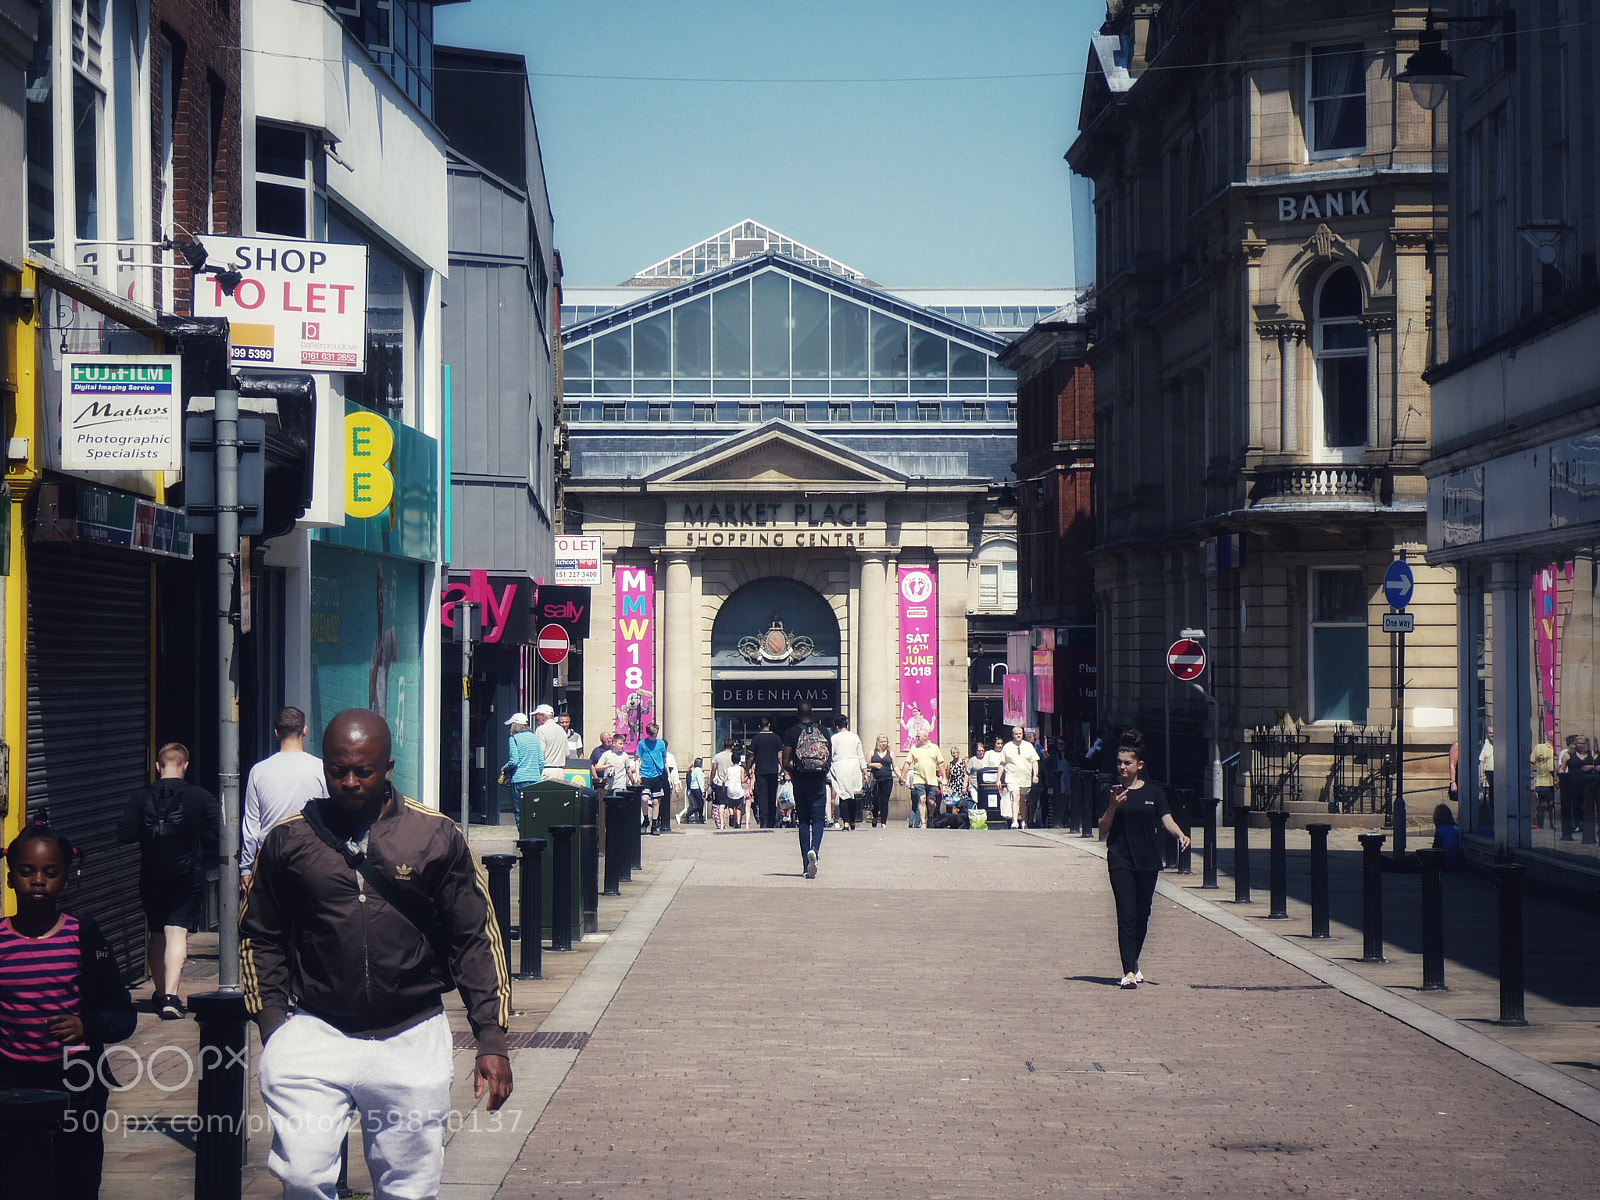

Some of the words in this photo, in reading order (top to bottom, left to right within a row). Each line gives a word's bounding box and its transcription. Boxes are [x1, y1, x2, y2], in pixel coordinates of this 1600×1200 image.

[1278, 188, 1370, 221] BANK
[235, 246, 327, 274] SHOP
[206, 277, 266, 310] TO
[283, 281, 355, 315] LET
[248, 349, 272, 360] 5399
[302, 351, 319, 360] 0161
[321, 352, 335, 361] 631
[337, 353, 356, 361] 2852
[74, 384, 97, 392] Digital
[98, 384, 127, 392] Imaging
[72, 401, 168, 424] Mathers
[77, 433, 171, 446] Photographic
[86, 448, 159, 460] Specialists
[683, 503, 782, 526] MARKET
[795, 503, 867, 526] PLACE
[572, 540, 597, 551] LET
[686, 532, 784, 547] SHOPPING
[795, 532, 865, 547] CENTRE
[441, 569, 518, 643] ally
[544, 601, 585, 623] sally
[1385, 618, 1397, 627] One
[1399, 620, 1410, 628] way
[905, 633, 930, 643] SAT
[906, 644, 929, 654] 16TH
[902, 655, 934, 665] JUNE
[904, 666, 932, 677] 2018
[723, 689, 828, 701] DEBENHAMS
